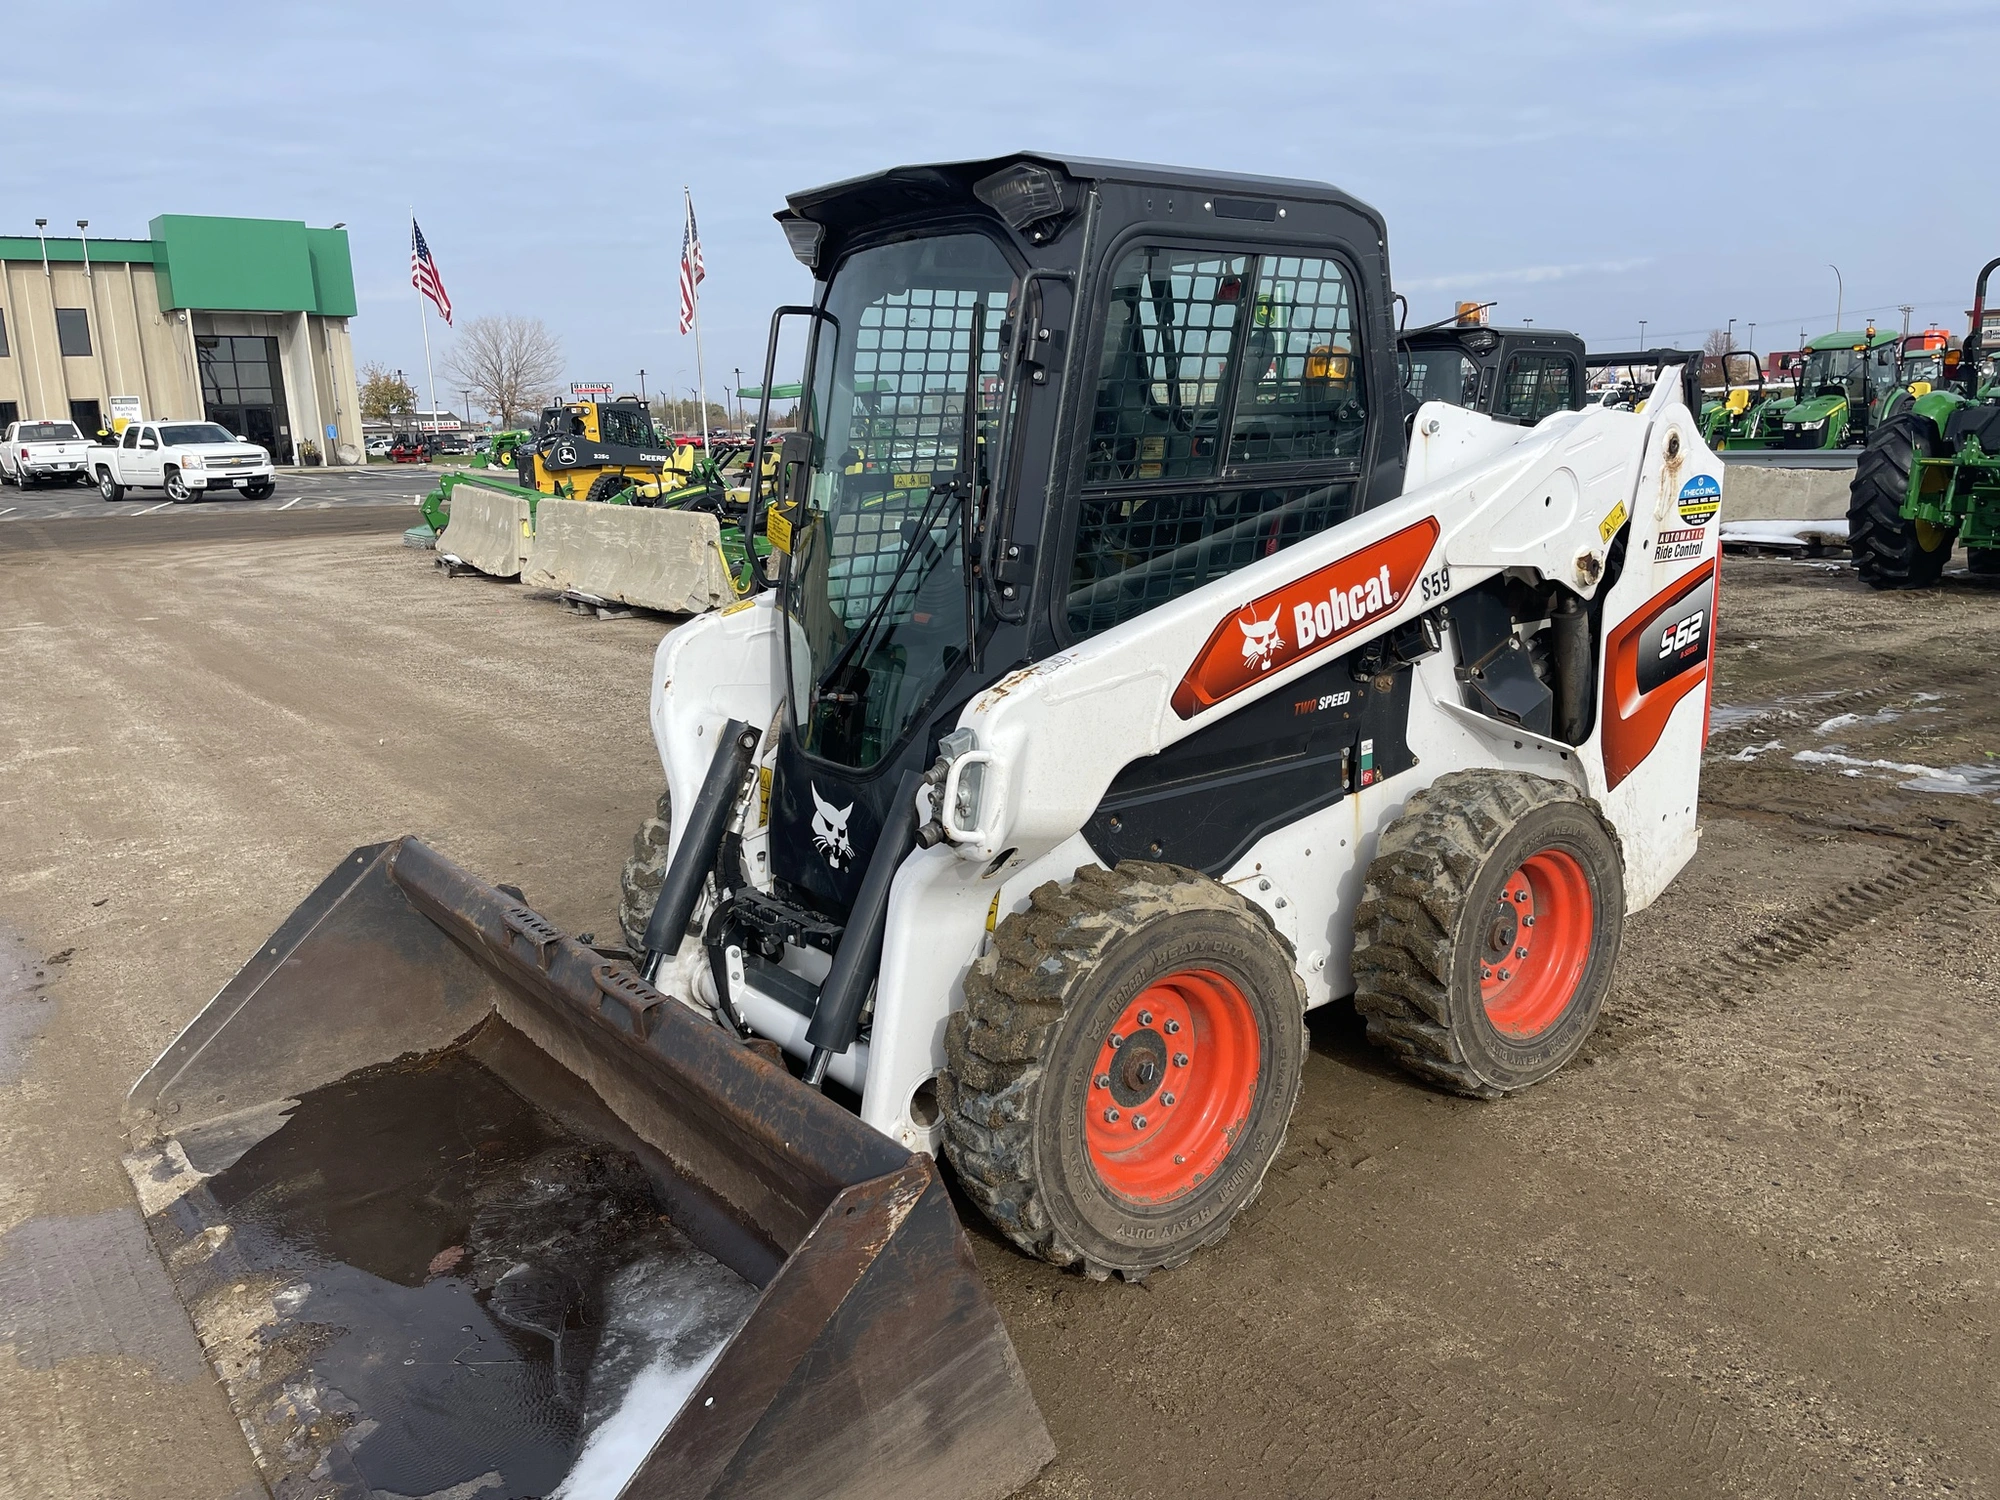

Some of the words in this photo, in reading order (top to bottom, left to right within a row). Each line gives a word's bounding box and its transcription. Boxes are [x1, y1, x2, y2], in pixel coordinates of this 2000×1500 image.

[640, 453, 667, 462] DEERE
[1683, 488, 1705, 497] THECO
[1654, 545, 1673, 560] Ride
[1674, 541, 1703, 557] Control
[1659, 529, 1704, 543] AUTOMATIC
[1421, 567, 1450, 601] S59
[1293, 564, 1393, 649] Bobcat
[1659, 610, 1704, 659] S62
[1294, 699, 1317, 716] TWO
[1318, 691, 1350, 710] SPEED
[1108, 966, 1147, 1014] Bobcat
[1156, 940, 1210, 966] HEAVY
[1069, 1152, 1093, 1204] BEAD
[1116, 1223, 1155, 1239] DUTY
[1161, 1205, 1211, 1238] HEAVY
